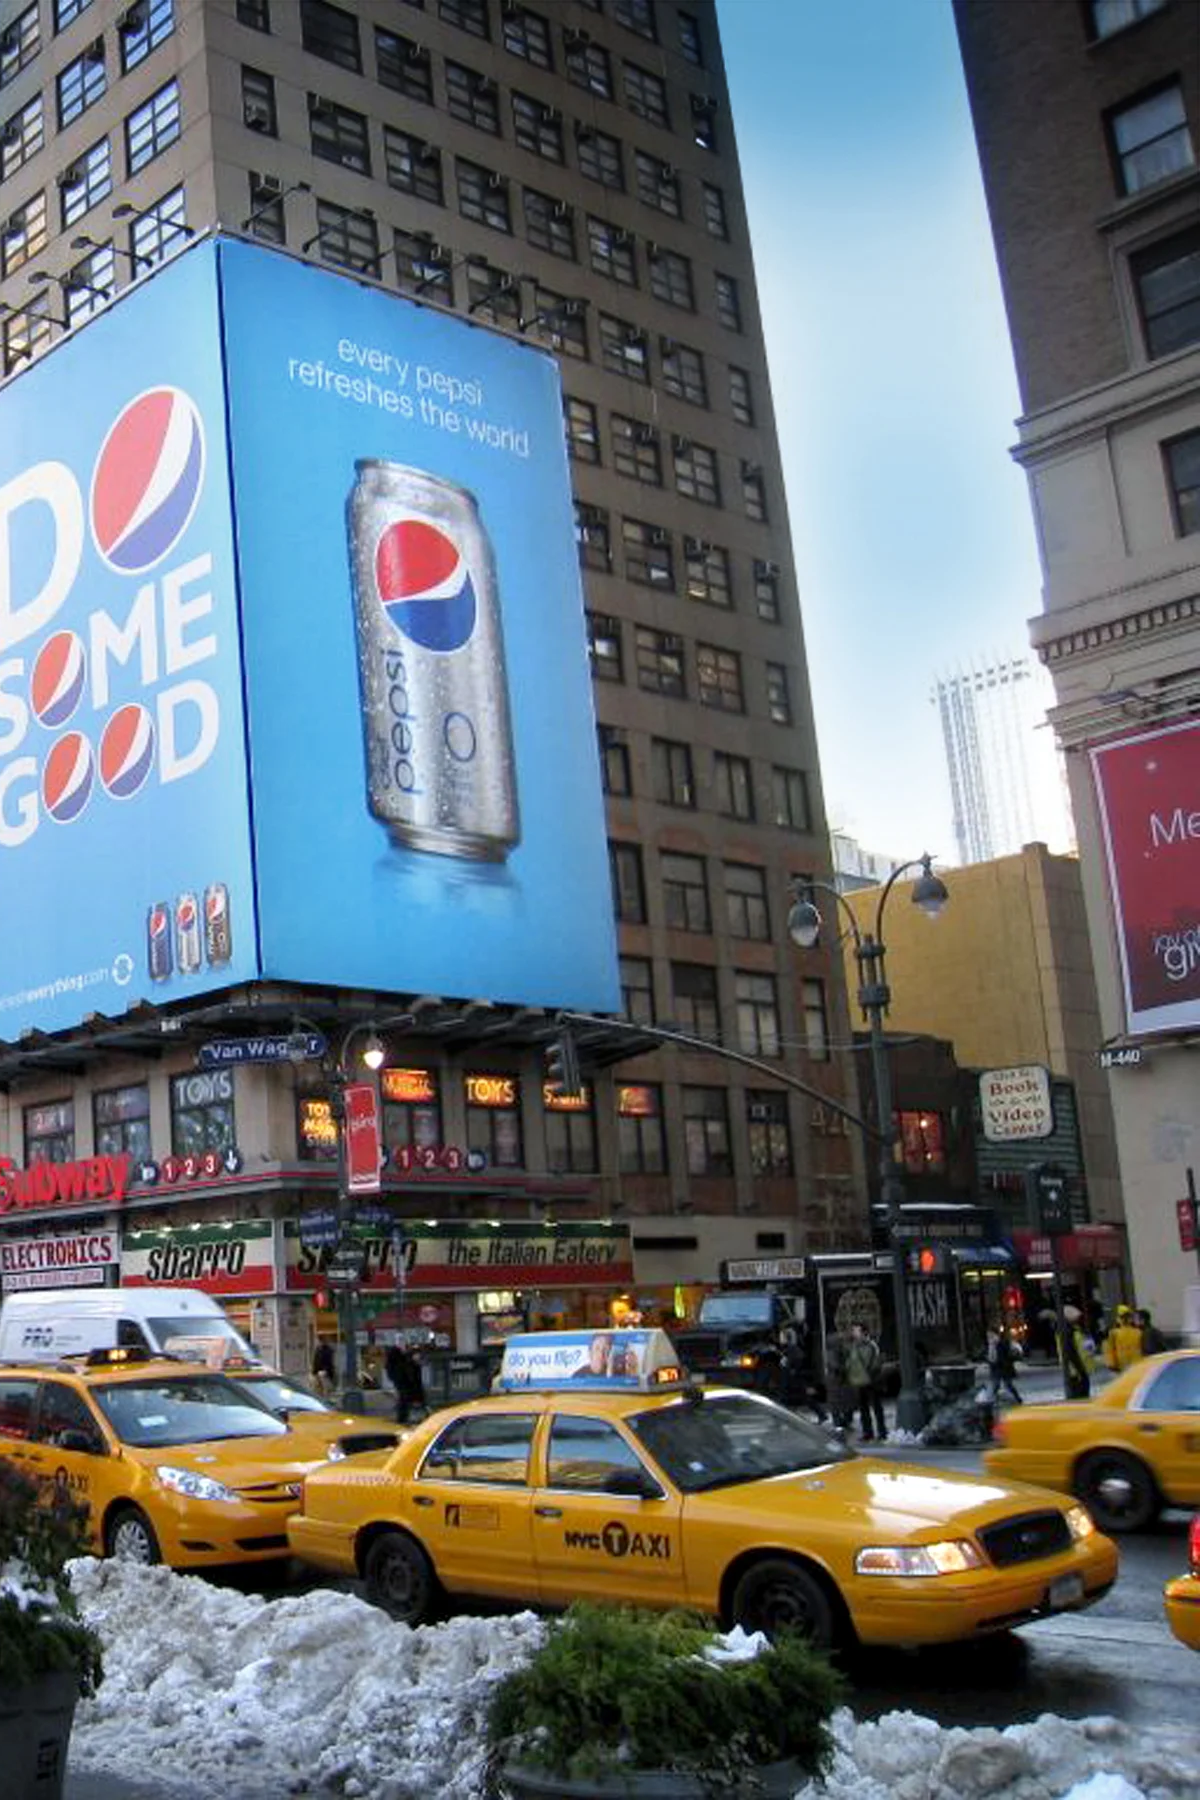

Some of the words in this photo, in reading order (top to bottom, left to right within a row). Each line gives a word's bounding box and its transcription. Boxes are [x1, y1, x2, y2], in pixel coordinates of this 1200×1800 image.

[338, 338, 409, 385] every
[416, 366, 482, 407] pepsi
[288, 357, 414, 419] refreshes
[420, 397, 460, 432] the
[465, 419, 529, 458] world
[382, 649, 425, 795] pepsi
[211, 1046, 243, 1059] Van
[248, 1039, 317, 1056] Wagr
[175, 1070, 232, 1106] TOYS
[465, 1077, 514, 1102] TOYS
[990, 1079, 1039, 1096] Book
[989, 1108, 1045, 1123] Video
[2, 1236, 113, 1270] ELECTRONICS
[146, 1238, 246, 1281] sbarro
[447, 1239, 481, 1264] the
[487, 1239, 548, 1264] Italian
[553, 1238, 617, 1266] Eatery
[508, 1350, 524, 1366] do
[527, 1353, 550, 1368] you
[564, 1531, 600, 1549] NYC
[602, 1521, 671, 1559] TAXI
